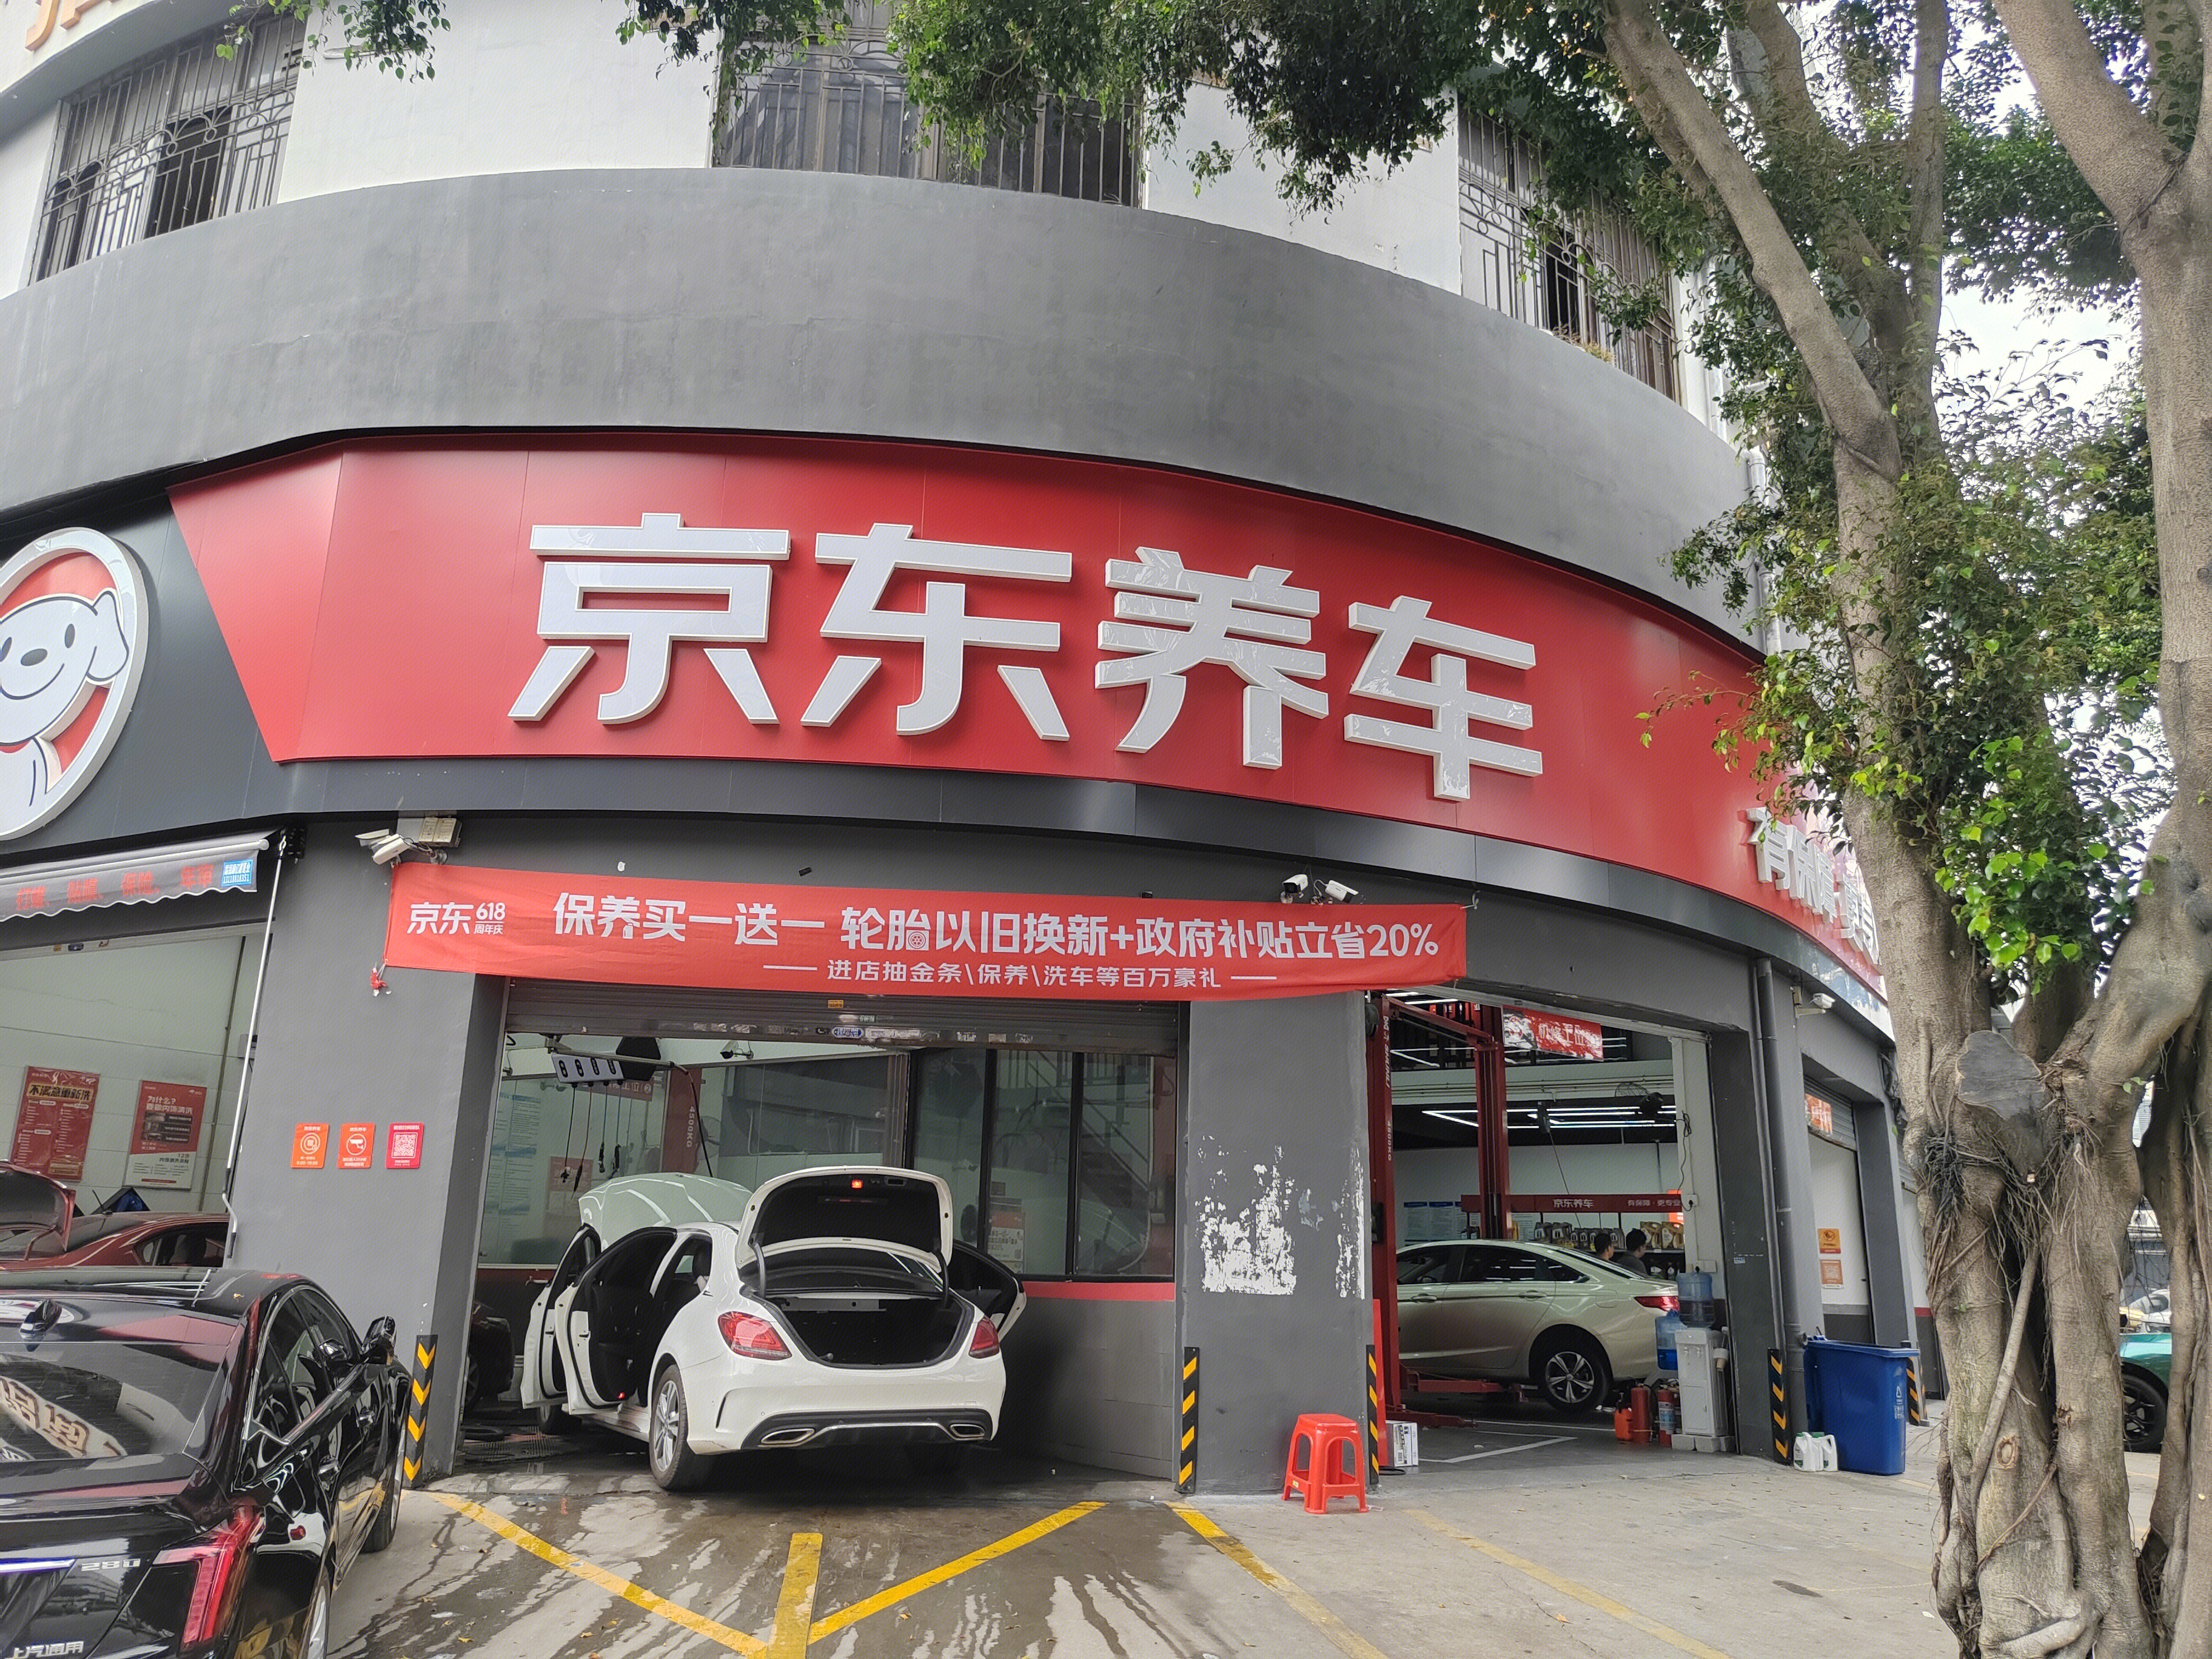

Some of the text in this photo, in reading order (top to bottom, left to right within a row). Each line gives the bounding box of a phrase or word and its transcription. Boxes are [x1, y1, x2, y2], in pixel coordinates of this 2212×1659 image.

[507, 512, 1543, 802] 京东养车
[406, 902, 472, 934] 京东
[475, 902, 506, 920] 618
[474, 923, 504, 935] 周年庆
[553, 892, 1439, 959] 保养买一送一 轮胎以旧换新+政府补贴立省20%
[29, 1084, 90, 1101] 不满意重新洗
[686, 1105, 695, 1148] 4500KG
[1553, 1199, 1594, 1208] 京东养车
